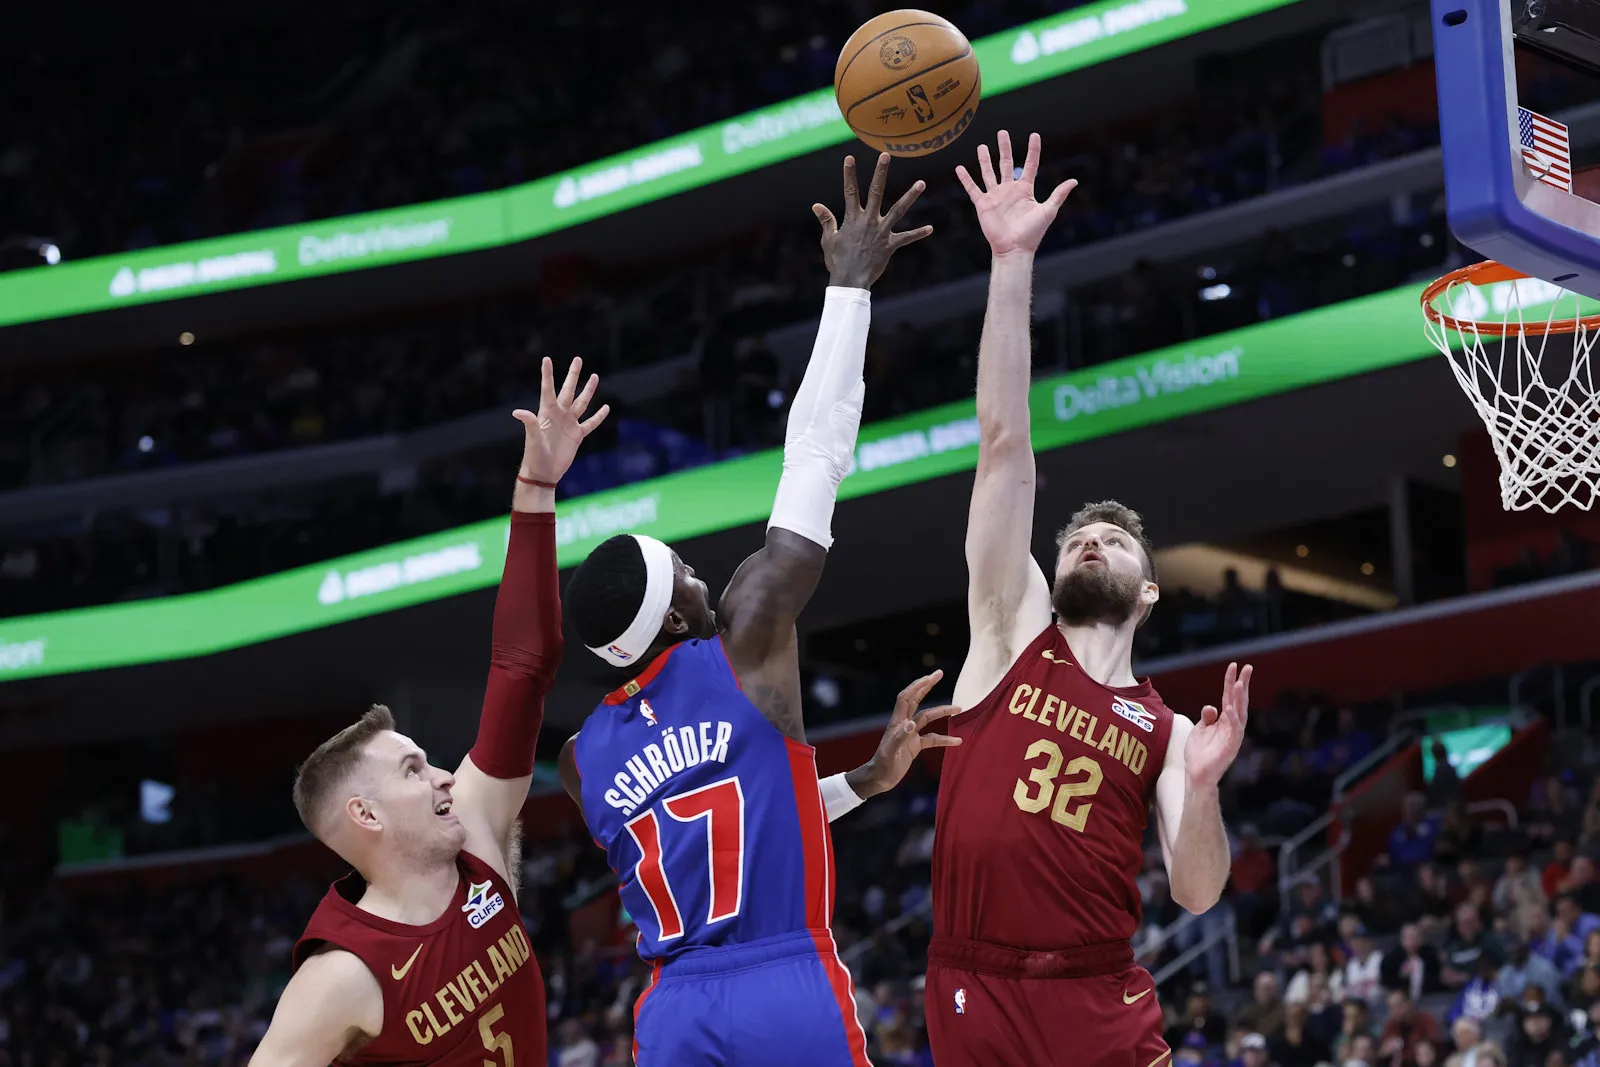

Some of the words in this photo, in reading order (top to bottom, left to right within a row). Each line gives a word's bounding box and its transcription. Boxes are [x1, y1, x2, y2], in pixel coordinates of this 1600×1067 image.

[1008, 683, 1149, 776] CLEVELAND
[1113, 705, 1152, 731] CLIFFS
[604, 721, 733, 816] SCHRÖDER
[1013, 738, 1104, 833] 32
[623, 775, 745, 942] 17
[471, 895, 503, 926] CLIFFS
[405, 924, 530, 1045] CLEVELAND
[478, 1002, 515, 1067] 5
